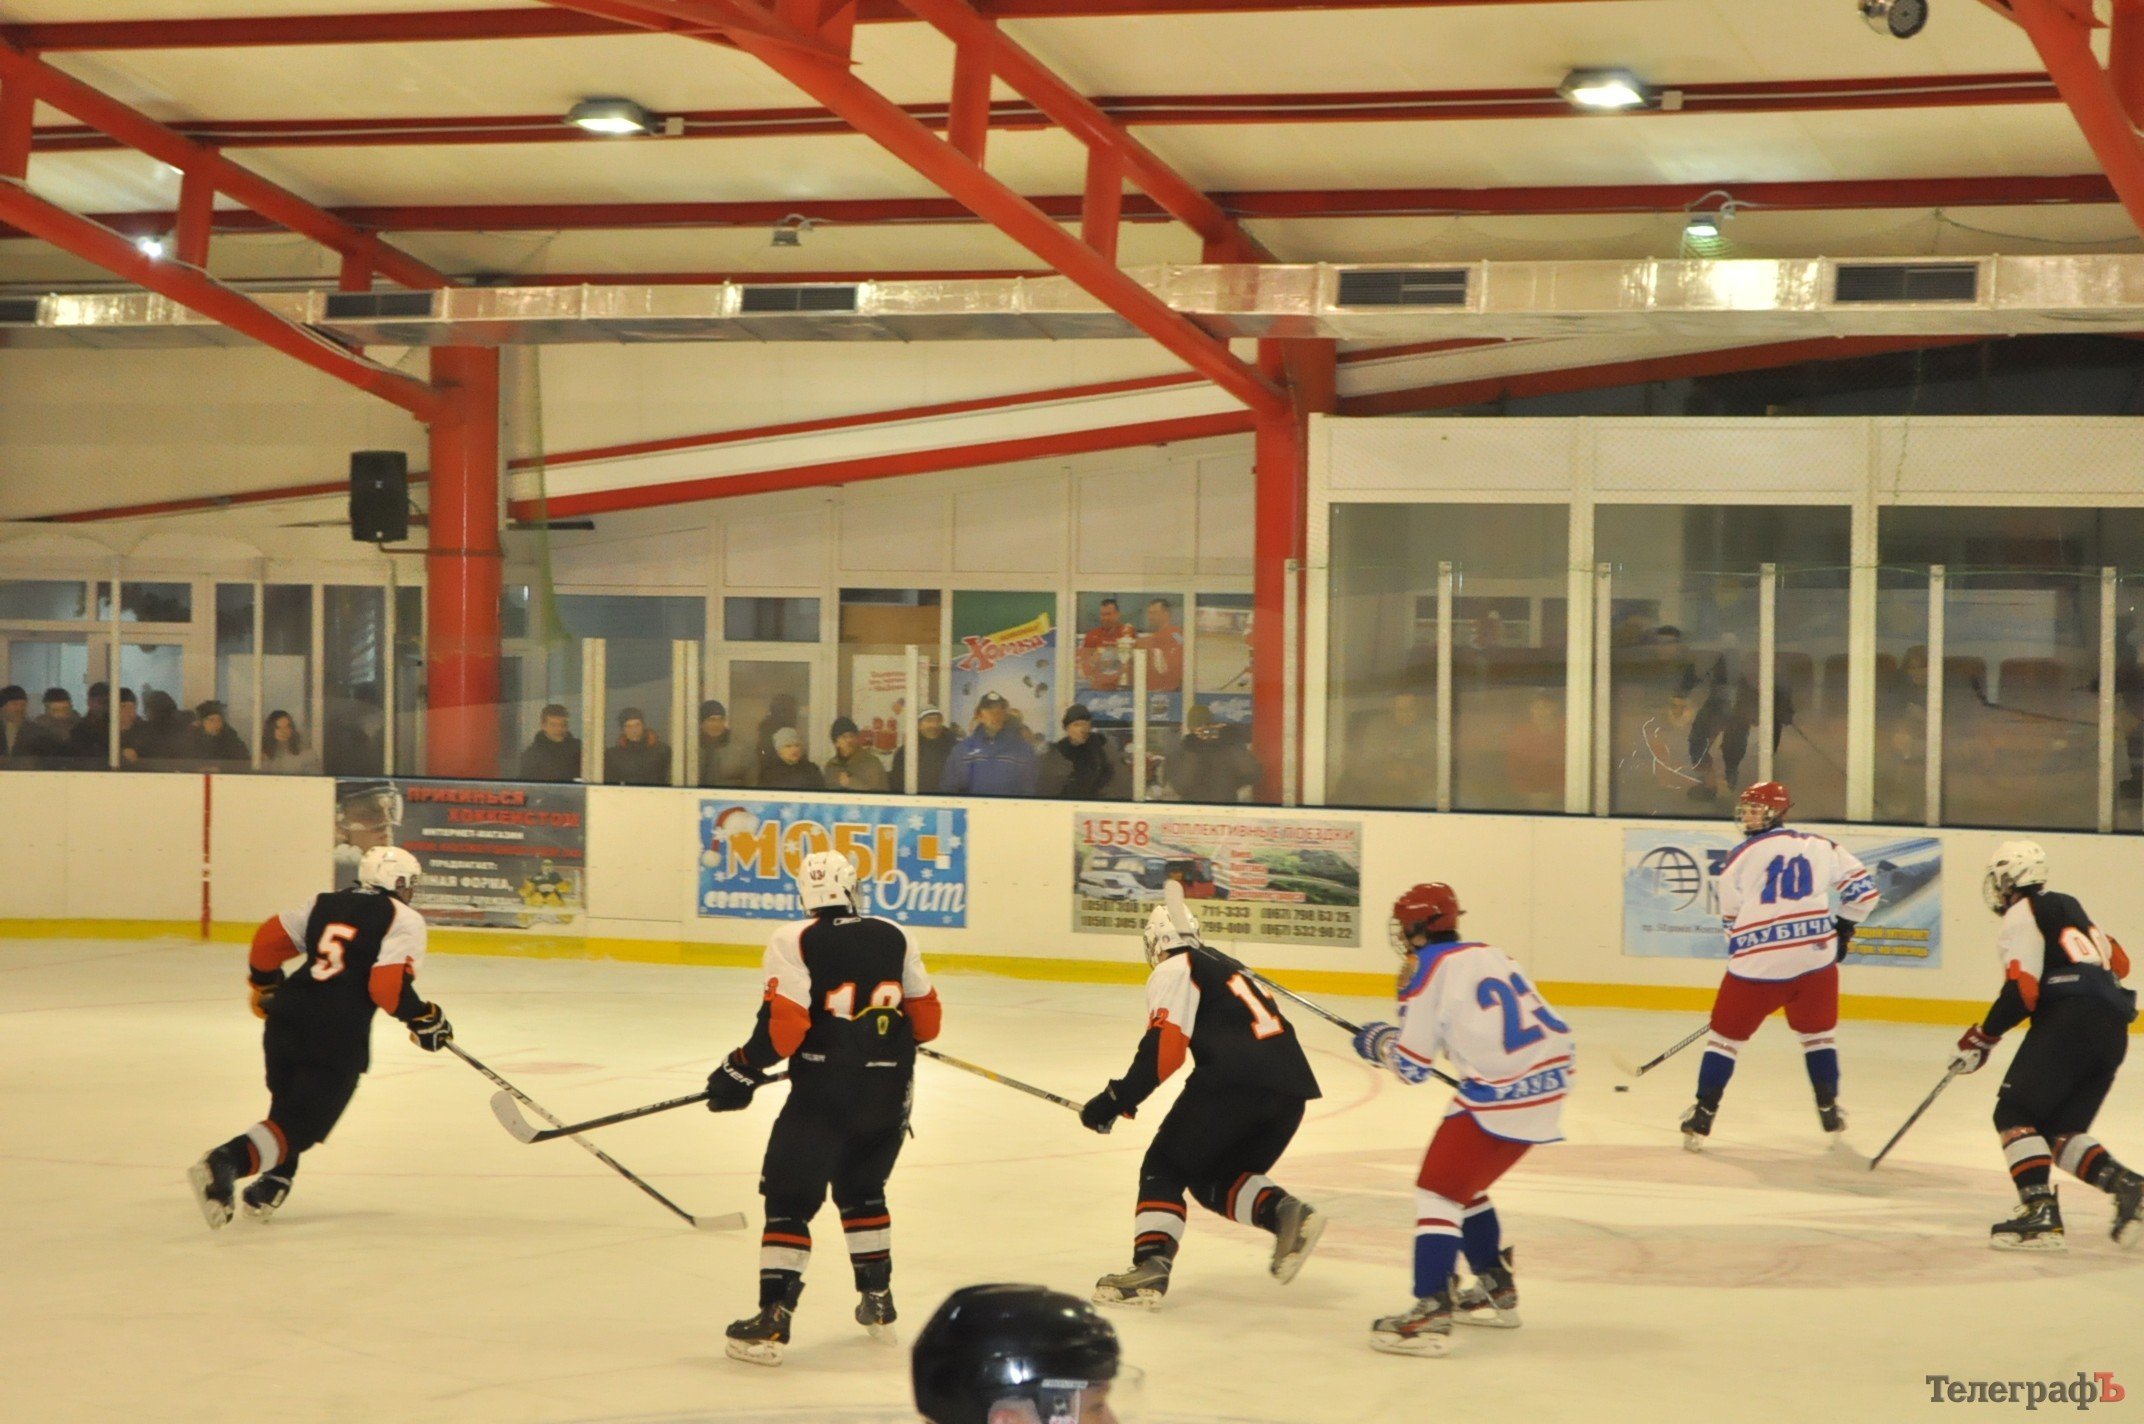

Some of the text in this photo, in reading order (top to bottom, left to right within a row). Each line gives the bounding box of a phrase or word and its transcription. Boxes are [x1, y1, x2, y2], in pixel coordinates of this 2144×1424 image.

[1082, 819, 1150, 846] 1558
[1284, 826, 1356, 841] ПОЕЗДКИ
[1760, 853, 1813, 905] 10
[310, 922, 359, 982] 5
